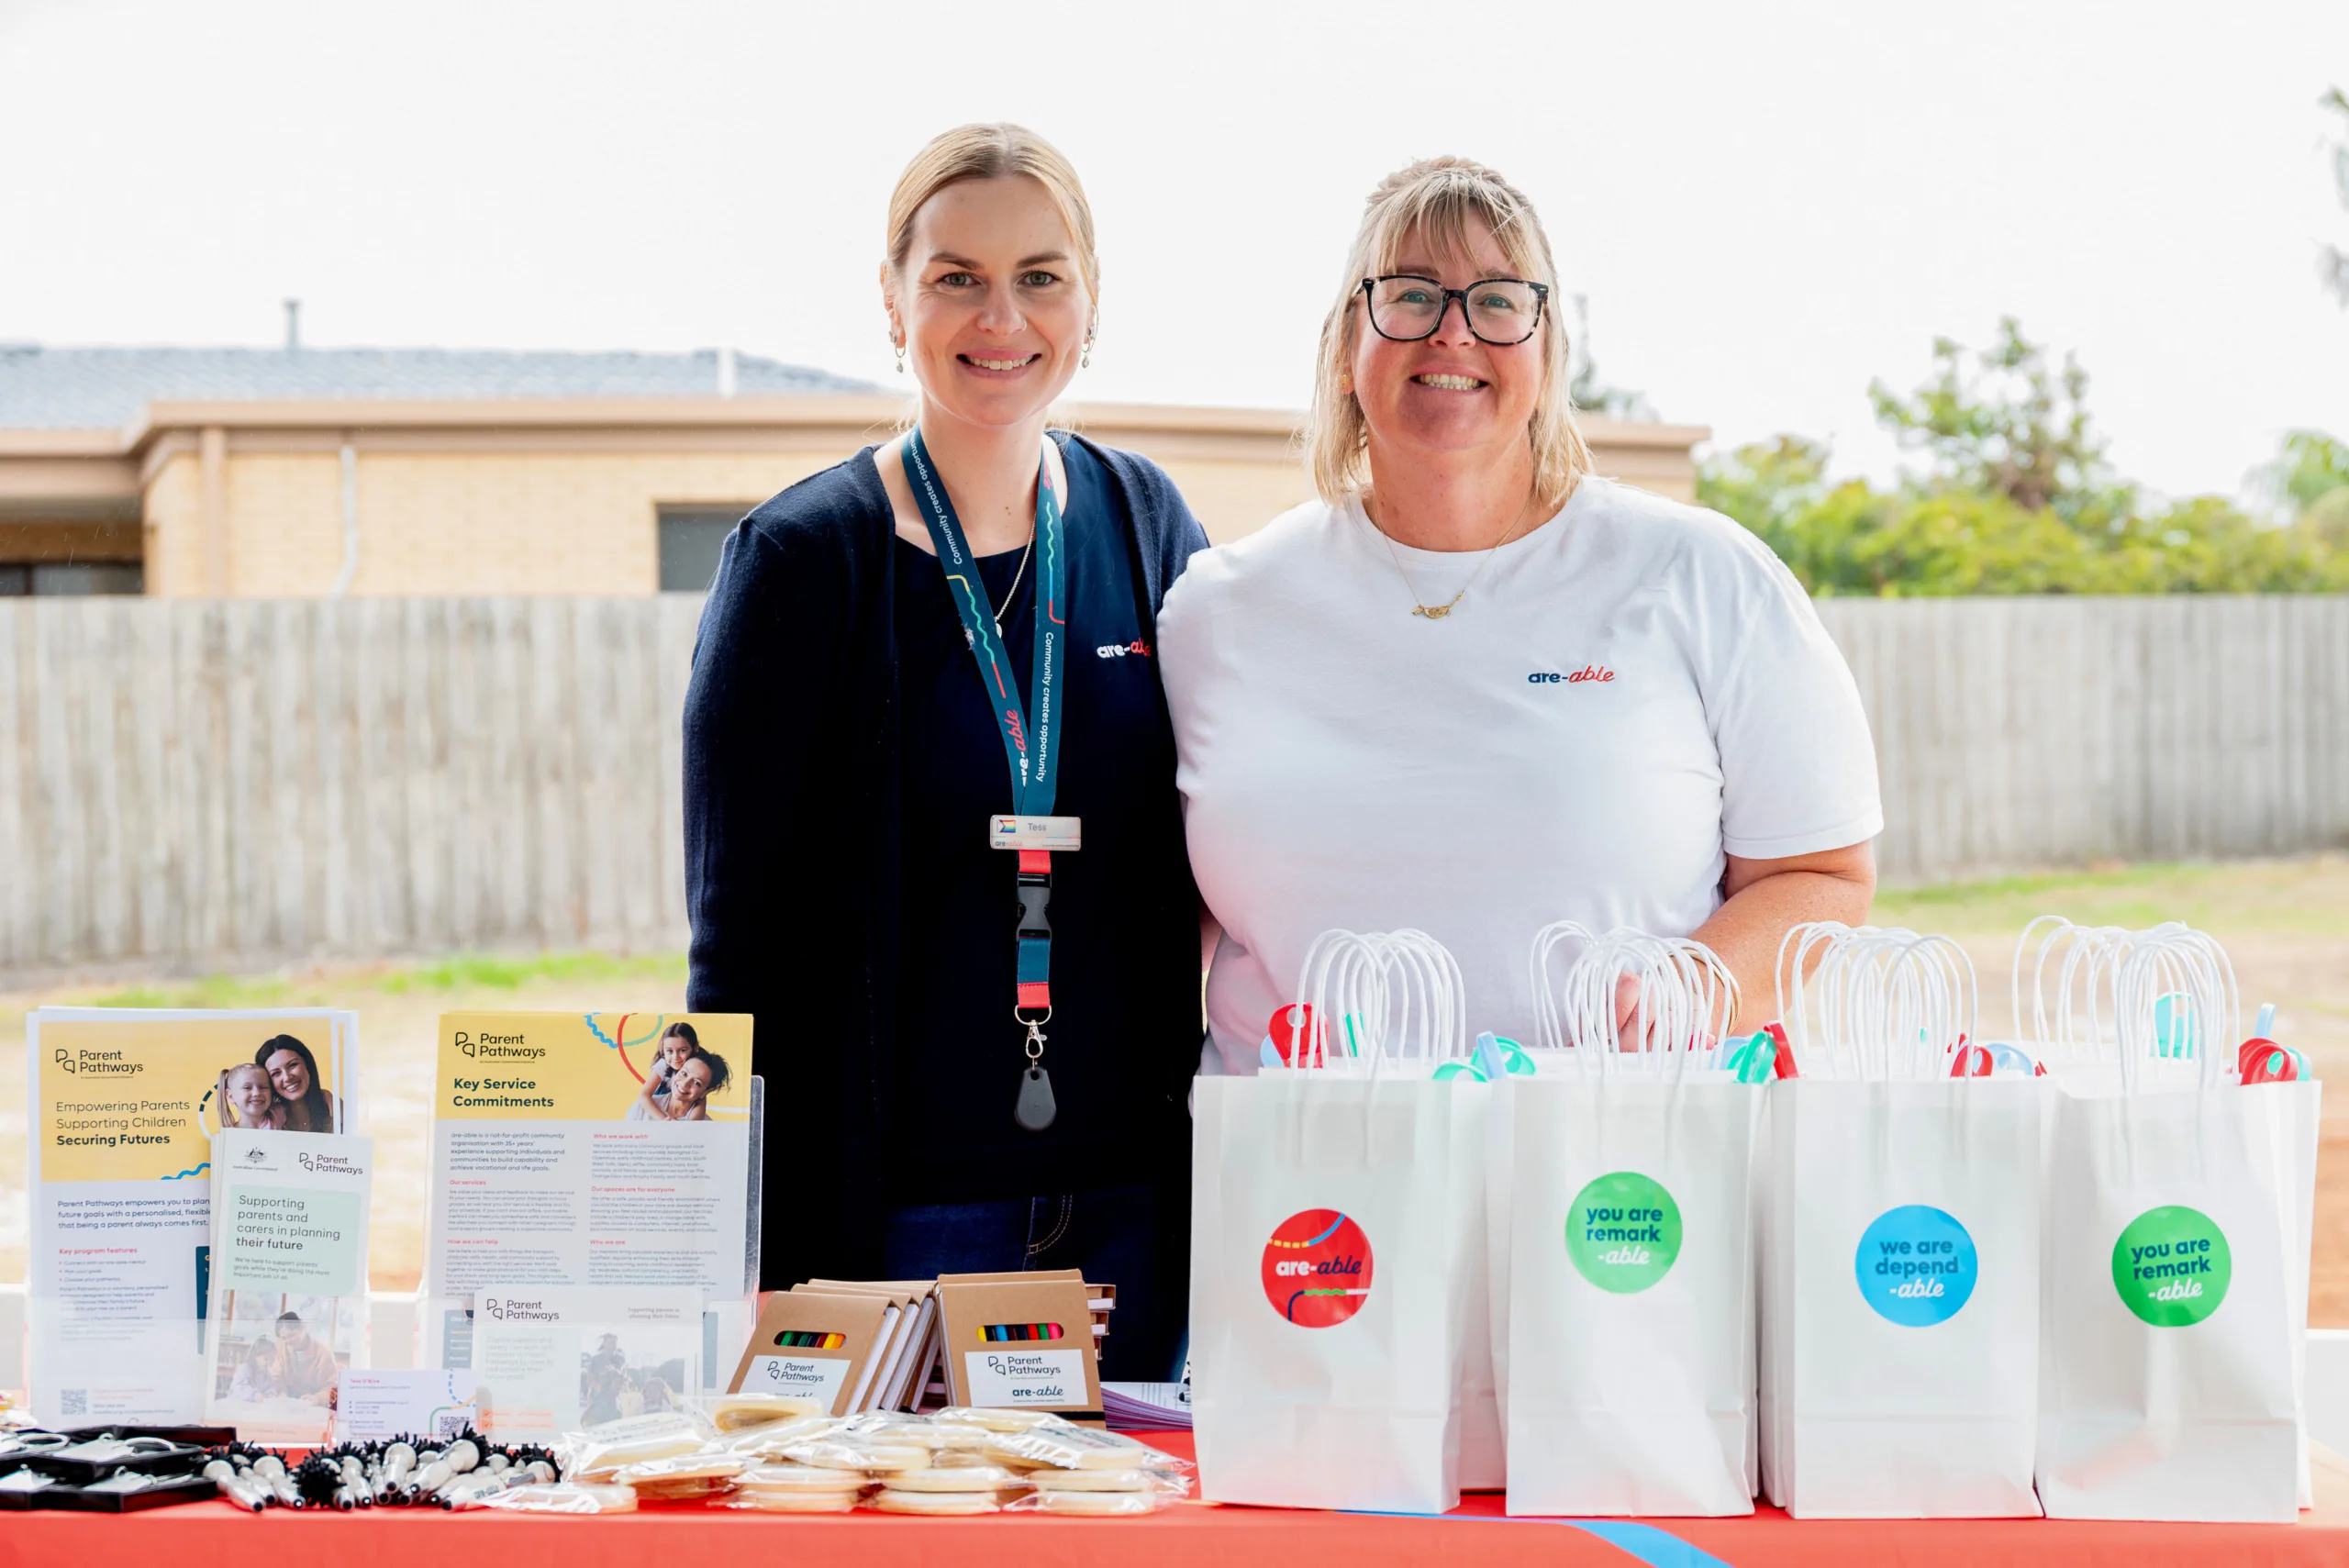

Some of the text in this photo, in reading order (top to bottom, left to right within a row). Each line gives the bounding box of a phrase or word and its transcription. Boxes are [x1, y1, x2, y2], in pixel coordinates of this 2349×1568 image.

[924, 481, 942, 514] creates
[938, 515, 963, 565] Community
[1528, 665, 1615, 684] are-able
[1036, 631, 1054, 782] Community creates opportunity
[1028, 822, 1047, 831] Tess
[995, 840, 1023, 848] are-able
[480, 1033, 525, 1044] Parent
[80, 1050, 123, 1061] Parent
[480, 1045, 546, 1059] Pathways
[80, 1062, 144, 1074] Pathways
[454, 1077, 536, 1092] Key Service
[56, 1100, 190, 1114] Empowering Parents
[453, 1095, 554, 1106] Commitments
[56, 1117, 186, 1130] Supporting Children
[57, 1134, 171, 1147] Securing Futures
[317, 1154, 348, 1164] Parent
[316, 1162, 363, 1175] Pathways
[85, 1199, 123, 1208] Pathways
[125, 1199, 165, 1207] empowers
[193, 1197, 210, 1206] plan
[239, 1195, 305, 1211] Supporting
[58, 1210, 82, 1218] future
[83, 1210, 105, 1219] goals
[106, 1209, 123, 1218] with
[132, 1209, 184, 1218] personalised,
[237, 1210, 308, 1223] parents and
[1586, 1207, 1664, 1225] you are
[76, 1221, 99, 1229] being
[107, 1220, 133, 1229] parent
[135, 1220, 162, 1229] always
[237, 1224, 340, 1241] carers in planning
[1586, 1224, 1661, 1241] remark
[236, 1237, 304, 1251] their future
[1879, 1240, 1953, 1254] we are
[1598, 1245, 1651, 1264] -able
[2131, 1239, 2210, 1264] you are
[1275, 1255, 1363, 1276] are-able
[1876, 1256, 1958, 1279] depend
[2132, 1255, 2211, 1281] remark
[1888, 1277, 1945, 1298] -able
[2148, 1277, 2203, 1301] -able
[507, 1299, 542, 1309] Parent
[507, 1309, 560, 1321] Pathways
[1008, 1356, 1042, 1365] Parent
[784, 1362, 815, 1373] Parent
[1008, 1365, 1061, 1375] Pathways
[780, 1372, 825, 1384] Pathways
[1012, 1385, 1063, 1396] are-able
